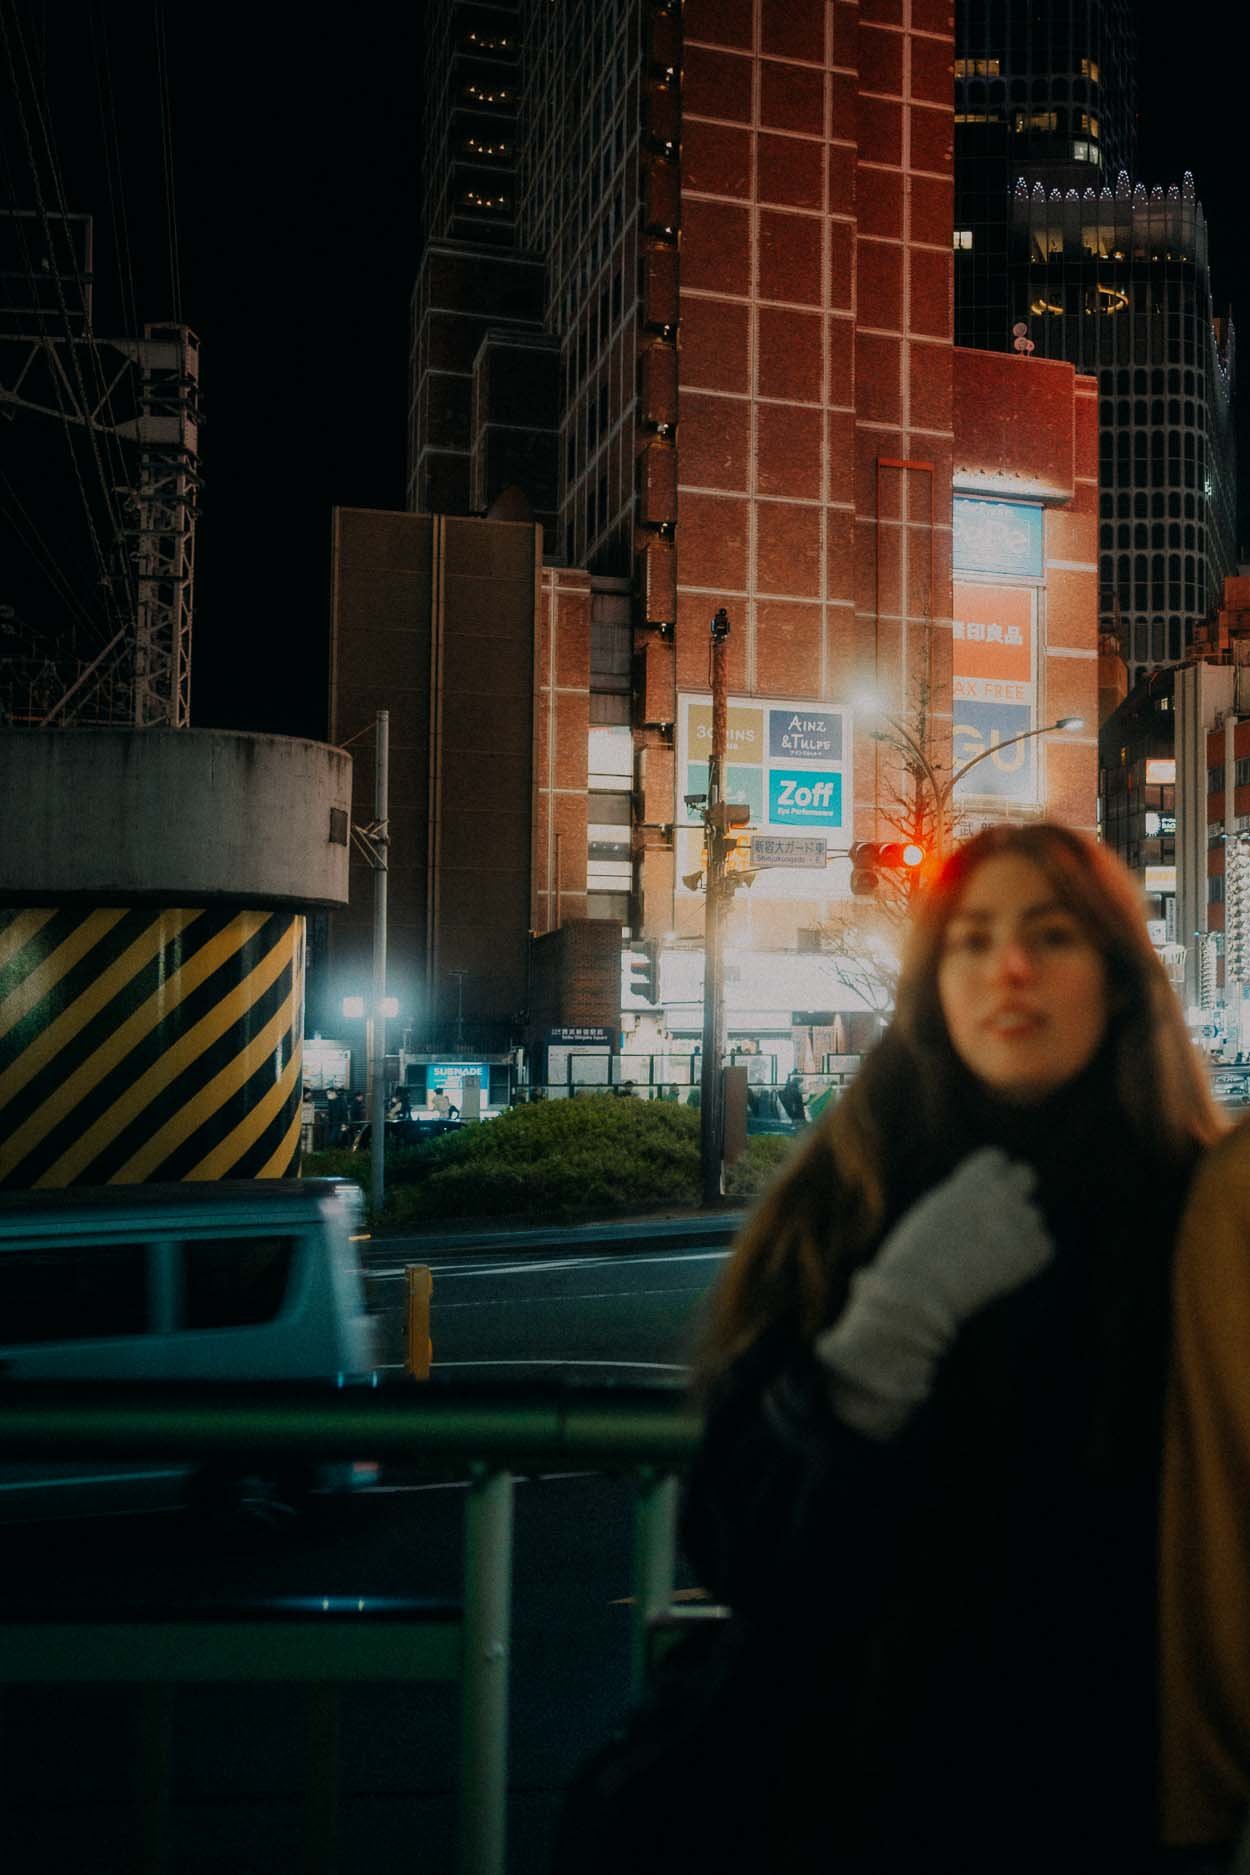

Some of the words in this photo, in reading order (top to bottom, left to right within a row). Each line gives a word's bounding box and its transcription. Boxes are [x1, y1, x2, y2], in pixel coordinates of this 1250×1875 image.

[984, 683, 1025, 700] FREE
[788, 714, 827, 733] AINZ
[781, 733, 832, 750] &TULPE
[953, 723, 1025, 774] GU
[778, 780, 834, 808] Zoff
